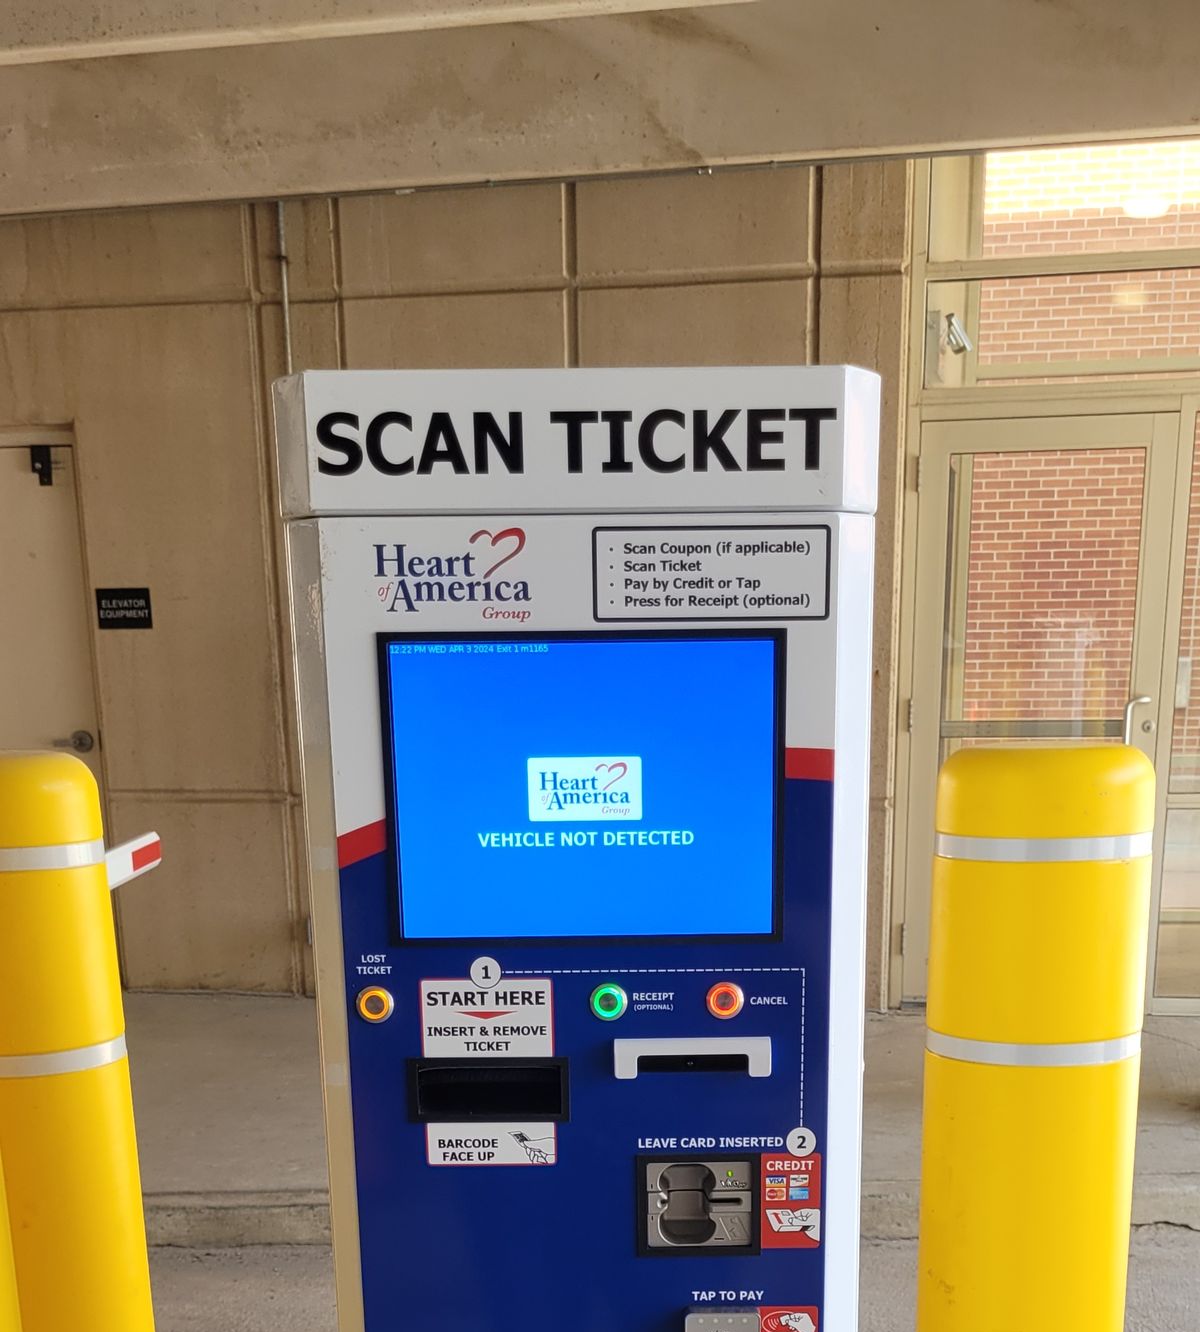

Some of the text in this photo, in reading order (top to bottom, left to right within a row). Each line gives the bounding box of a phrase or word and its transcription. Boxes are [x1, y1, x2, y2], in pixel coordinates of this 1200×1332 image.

[317, 408, 838, 476] SCAN TICKET
[623, 541, 811, 557] Scan Coupon (if applicable)
[373, 544, 476, 577] Heart
[623, 560, 702, 572] Scan Ticket
[624, 577, 761, 592] Pay by Credit or Tap
[378, 579, 532, 612] of America
[624, 593, 811, 608] Press for Receipt (optional)
[101, 599, 146, 608] ELEVATOR
[100, 610, 149, 618] EQUIPMENT
[482, 607, 531, 622] Group
[414, 645, 427, 654] PM
[428, 645, 446, 654] WED
[450, 645, 464, 653] APR
[467, 645, 472, 653] 3
[474, 644, 494, 653] 2024
[497, 644, 512, 653] Exit
[540, 772, 598, 790] Heart
[541, 791, 631, 810] of America
[601, 806, 631, 816] Group
[478, 831, 695, 847] VEHICLE NOT DETECTED
[361, 955, 386, 963] LOST
[356, 966, 392, 975] TICKET
[481, 966, 491, 979] 1
[426, 991, 545, 1006] START HERE
[632, 992, 674, 1001] RECEIPT
[750, 996, 788, 1005] CANCEL
[427, 1026, 547, 1037] INSERT & REMOVE
[464, 1041, 511, 1051] TICKET
[438, 1139, 498, 1149] BARCODE
[638, 1137, 783, 1149] LEAVE CARD INSERTED
[797, 1136, 806, 1149] 2
[442, 1152, 494, 1161] FACE UP
[766, 1160, 814, 1171] CREDIT
[692, 1290, 764, 1300] TAP TO PAY
